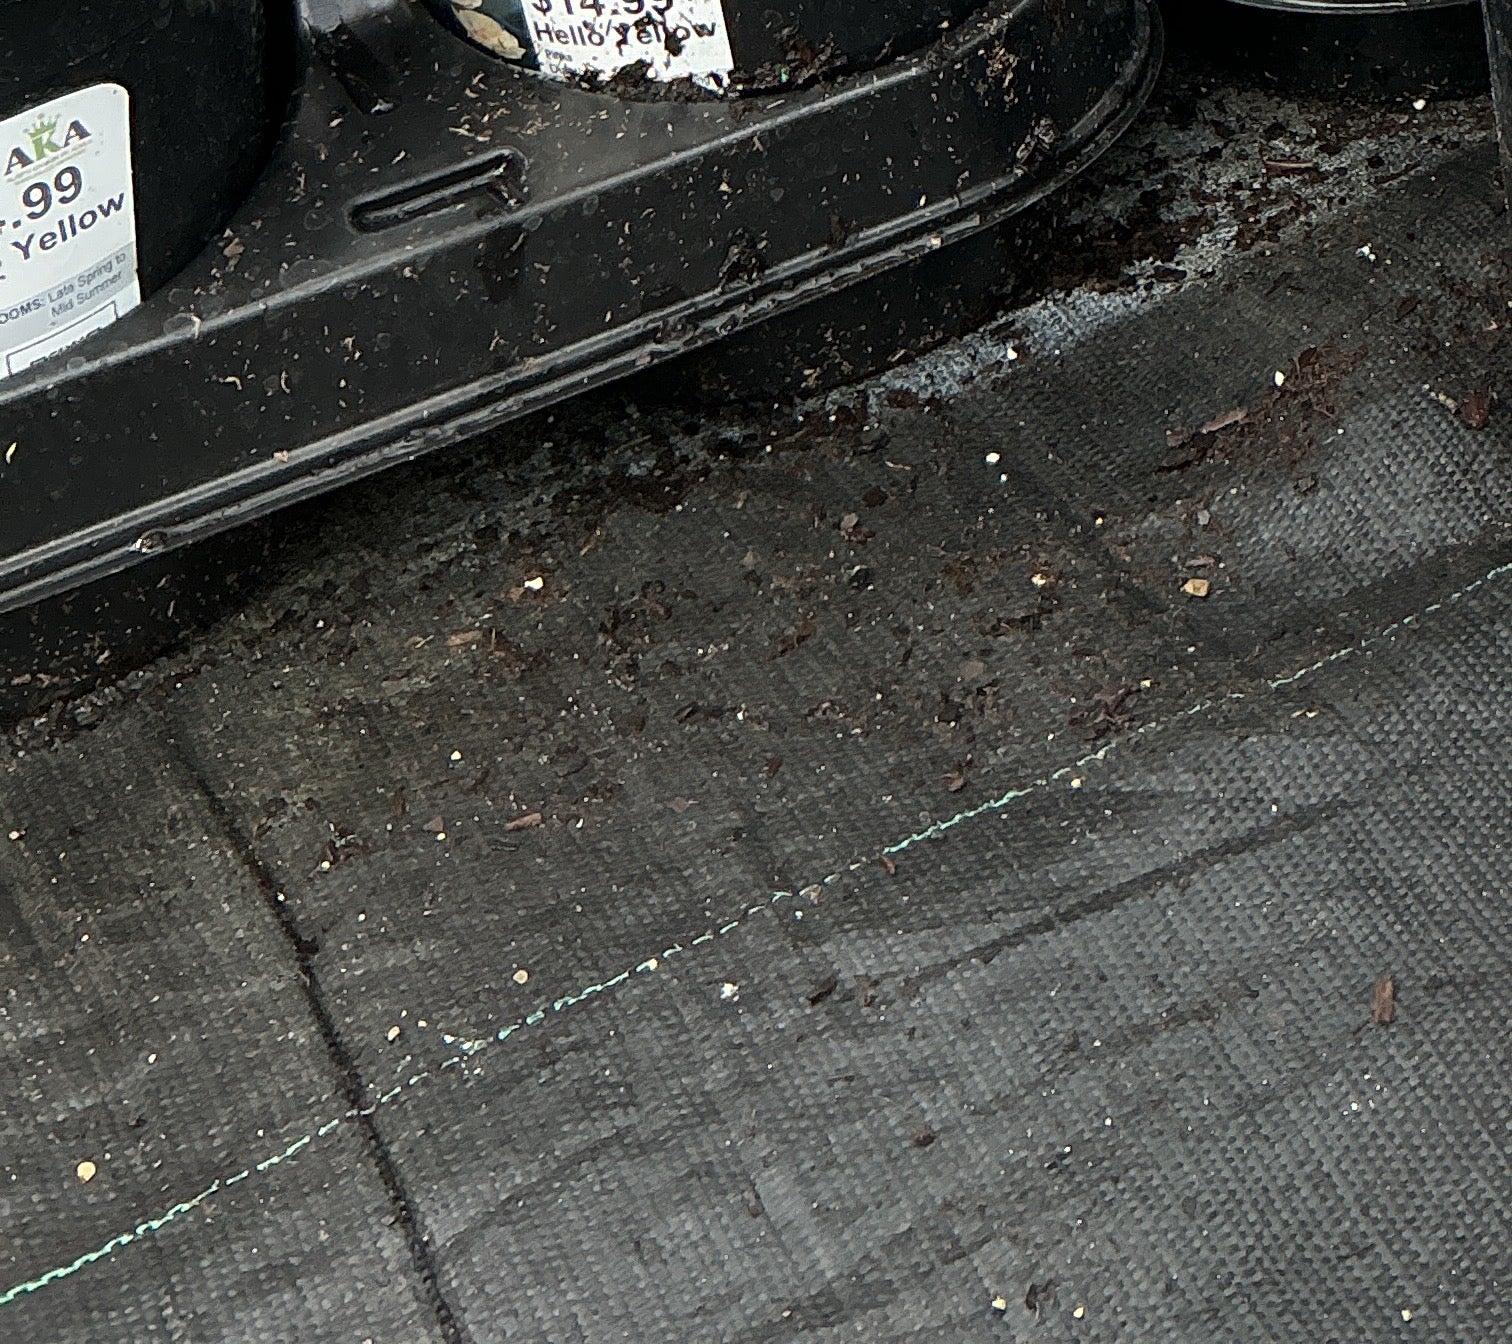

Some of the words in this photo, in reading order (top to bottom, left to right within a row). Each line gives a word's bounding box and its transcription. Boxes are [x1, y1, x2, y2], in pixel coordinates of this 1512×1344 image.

[533, 20, 605, 47] Hello
[613, 20, 717, 50] Yelow
[3, 119, 92, 176] AKA
[10, 192, 125, 261] Yellow
[47, 283, 75, 303] Late
[77, 261, 113, 287] Spring
[115, 252, 126, 265] to
[51, 299, 74, 318] Mid
[76, 272, 122, 305] Summer
